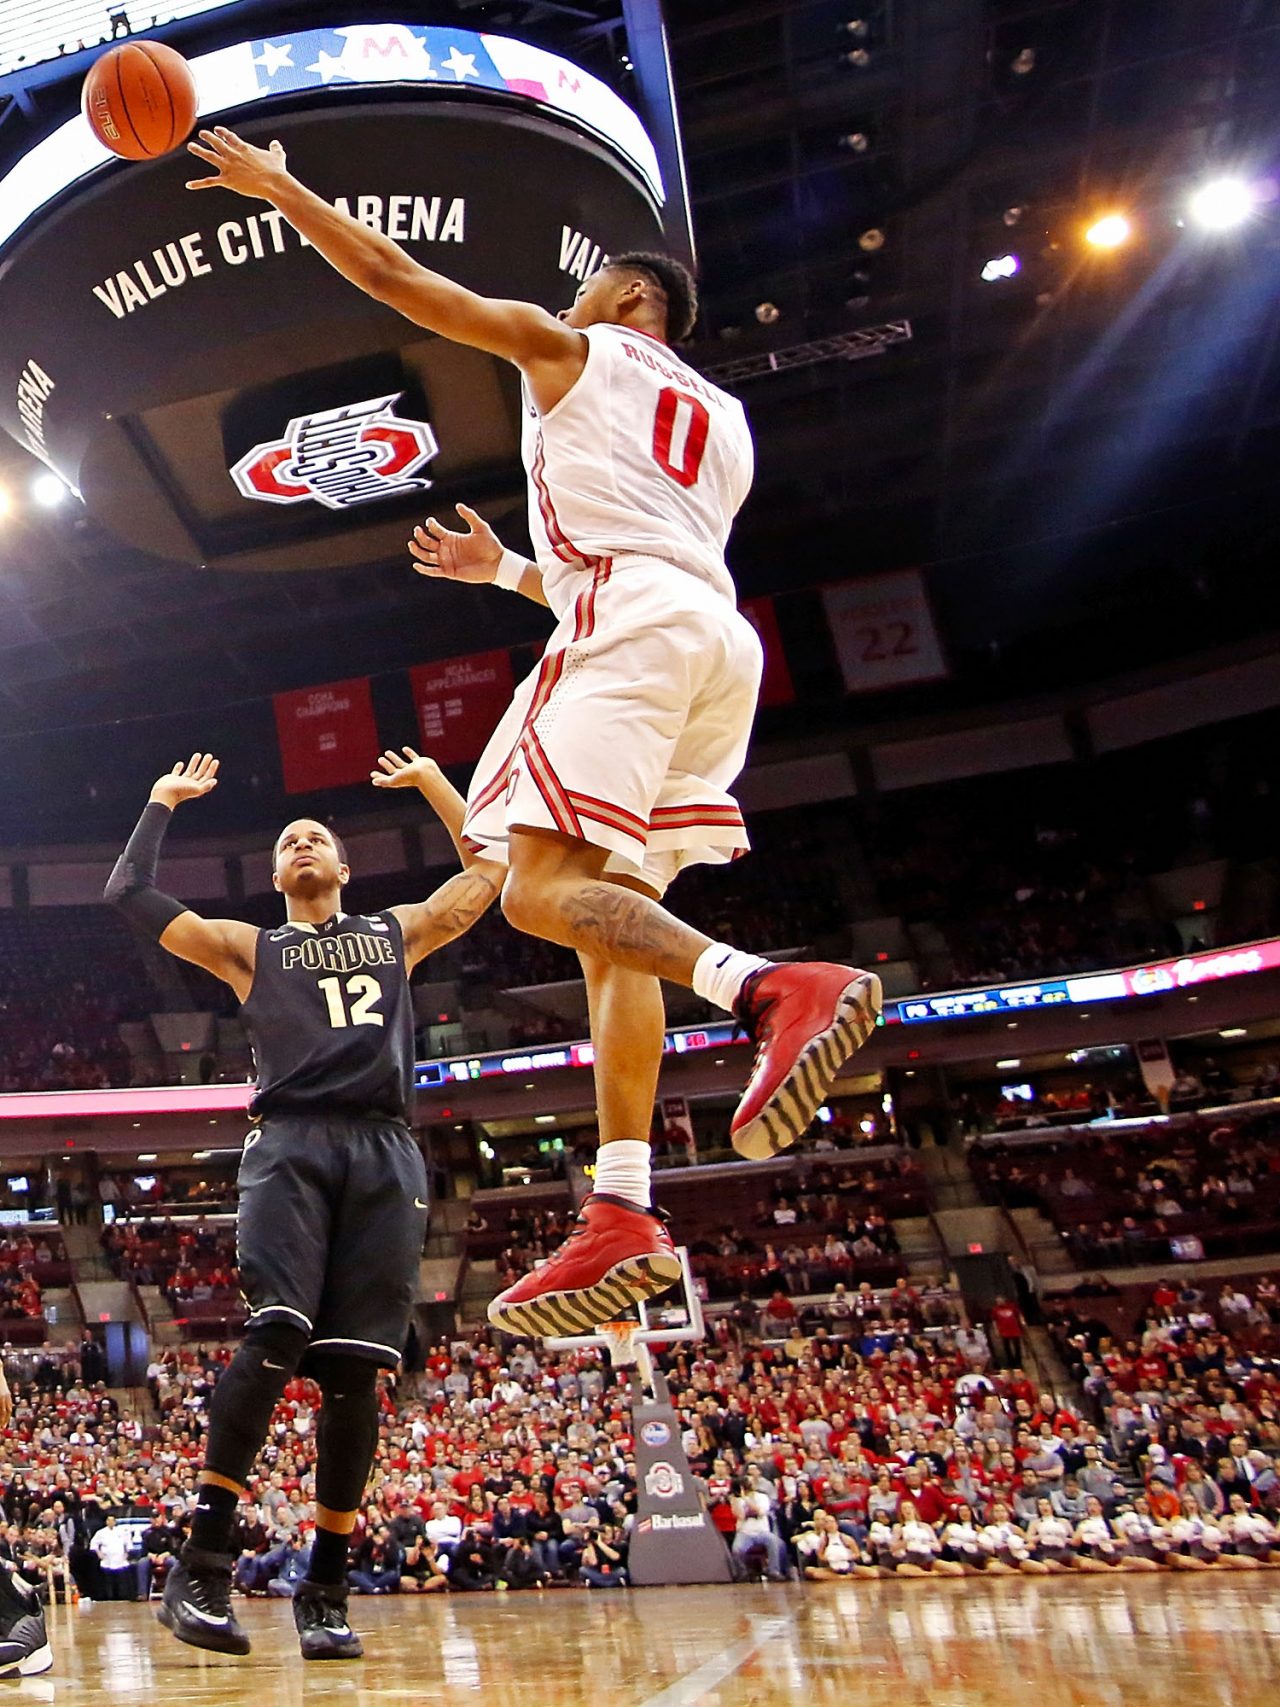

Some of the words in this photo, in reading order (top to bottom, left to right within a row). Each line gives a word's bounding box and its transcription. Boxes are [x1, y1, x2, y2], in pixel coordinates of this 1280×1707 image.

[92, 232, 213, 319] VALUE
[216, 207, 313, 266] CIT
[558, 224, 610, 281] VAL
[652, 386, 710, 488] 0
[856, 622, 918, 661] 22
[282, 932, 397, 973] PURDUE
[317, 974, 384, 1028] 12
[651, 1513, 705, 1530] Barbasol
